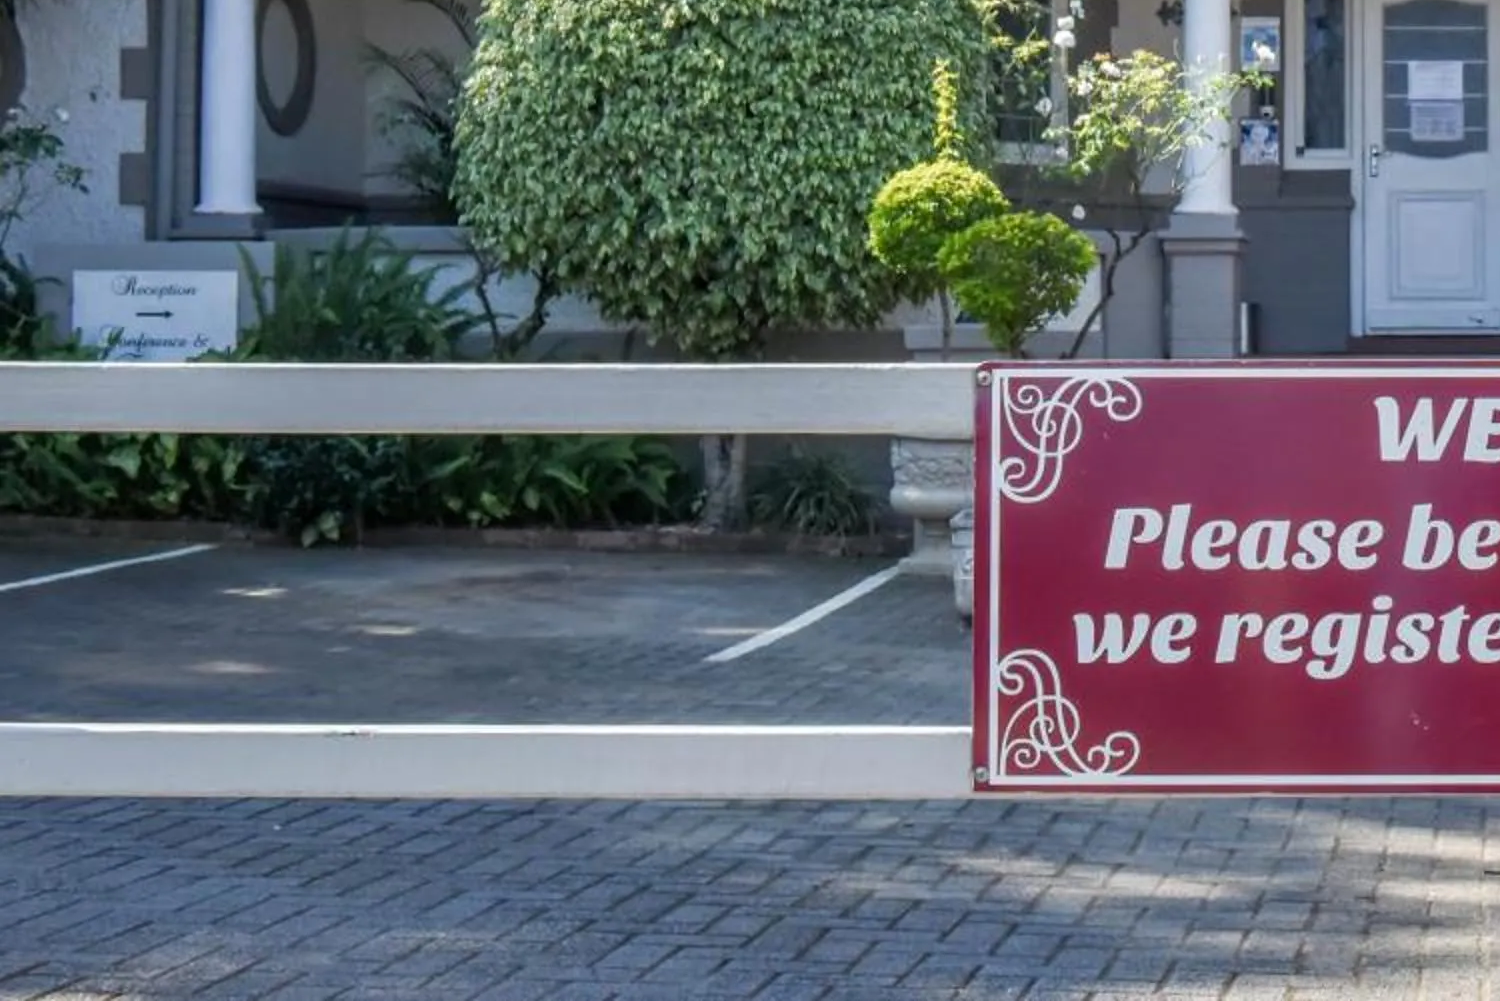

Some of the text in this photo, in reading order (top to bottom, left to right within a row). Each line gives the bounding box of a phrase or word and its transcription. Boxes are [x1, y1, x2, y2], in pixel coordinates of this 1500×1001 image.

[112, 275, 197, 299] Reception
[192, 334, 209, 348] &
[1105, 503, 1384, 570] Please
[1074, 612, 1196, 664] we
